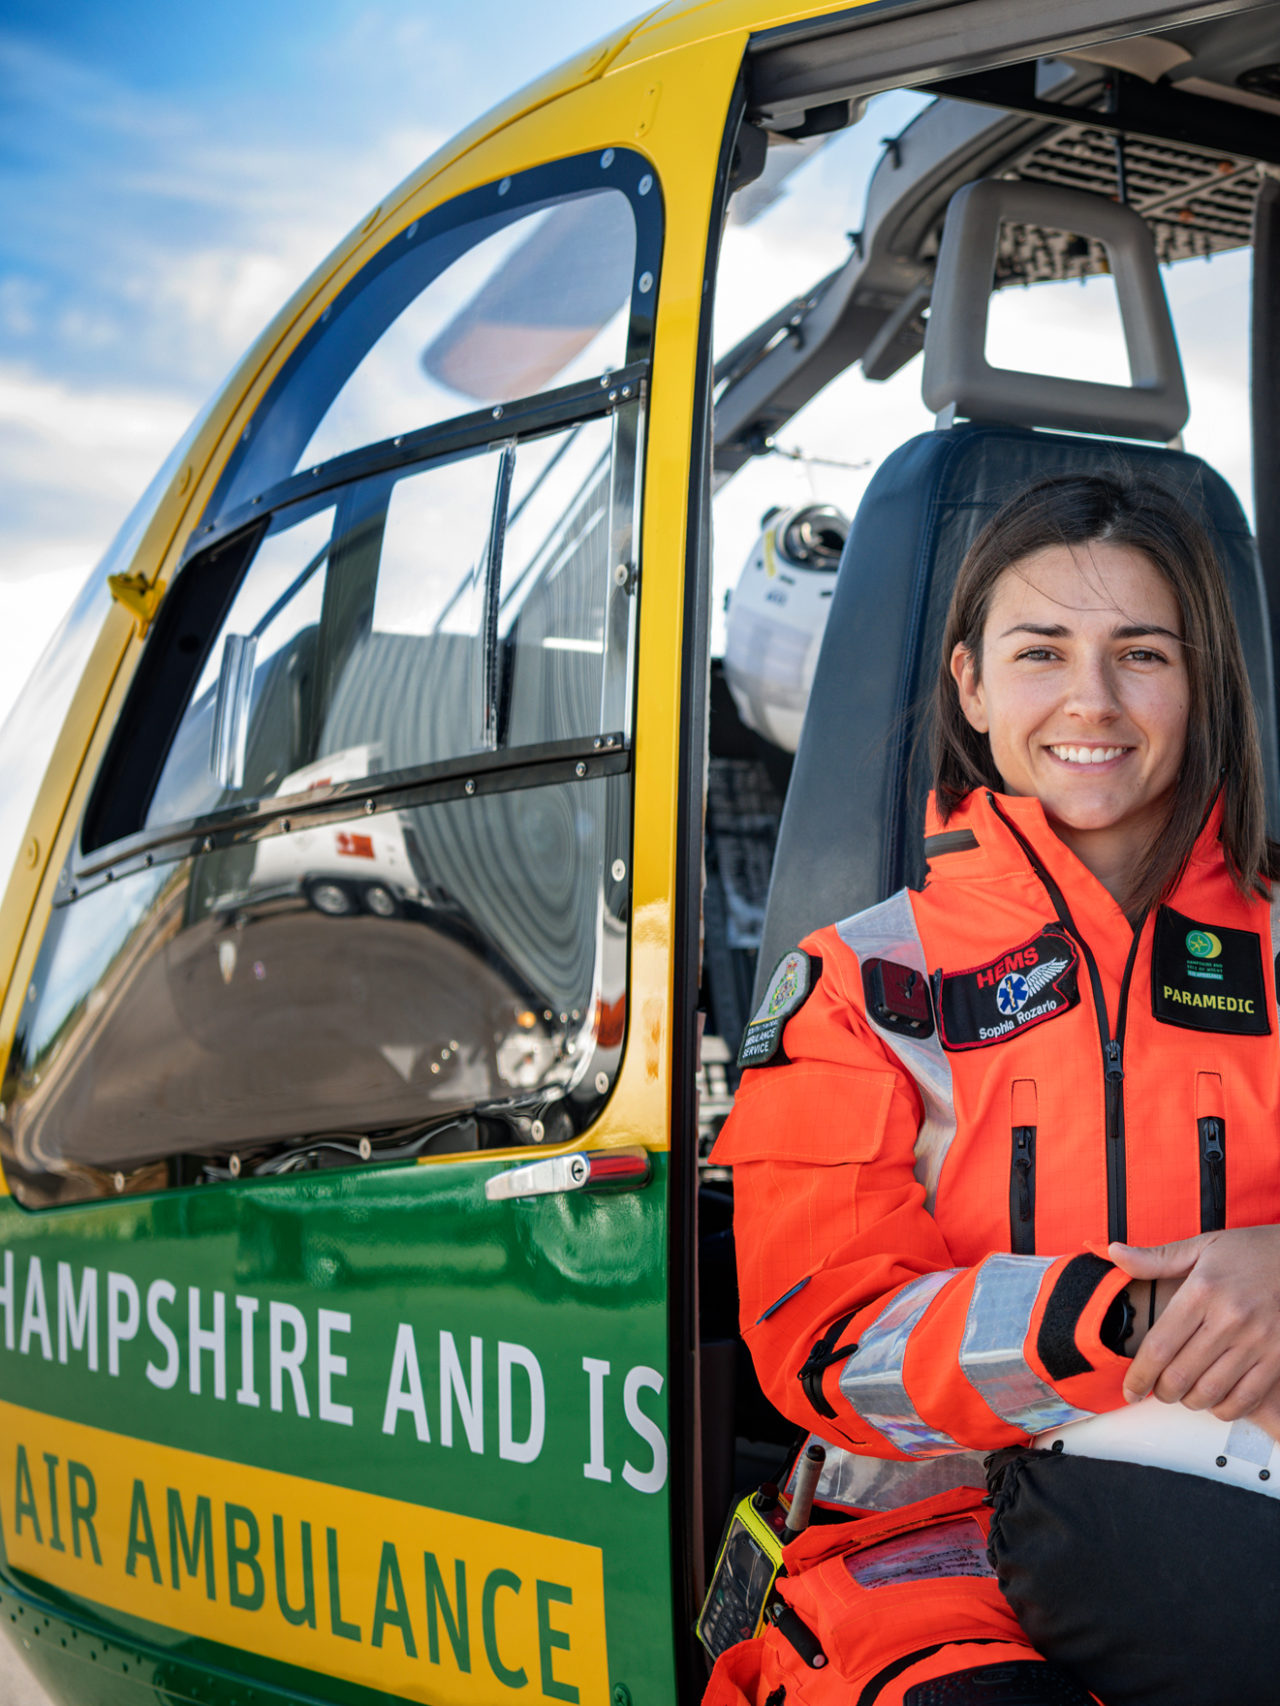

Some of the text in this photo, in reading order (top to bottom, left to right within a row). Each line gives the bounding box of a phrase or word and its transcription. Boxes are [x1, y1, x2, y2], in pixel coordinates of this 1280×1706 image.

[976, 946, 1039, 989] HEMS
[1163, 985, 1255, 1014] PARAMEDIC
[742, 1041, 769, 1059] SERVICE
[382, 1323, 546, 1465] AND
[581, 1356, 669, 1494] IS
[13, 1443, 581, 1706] AIR AMBULANCE
